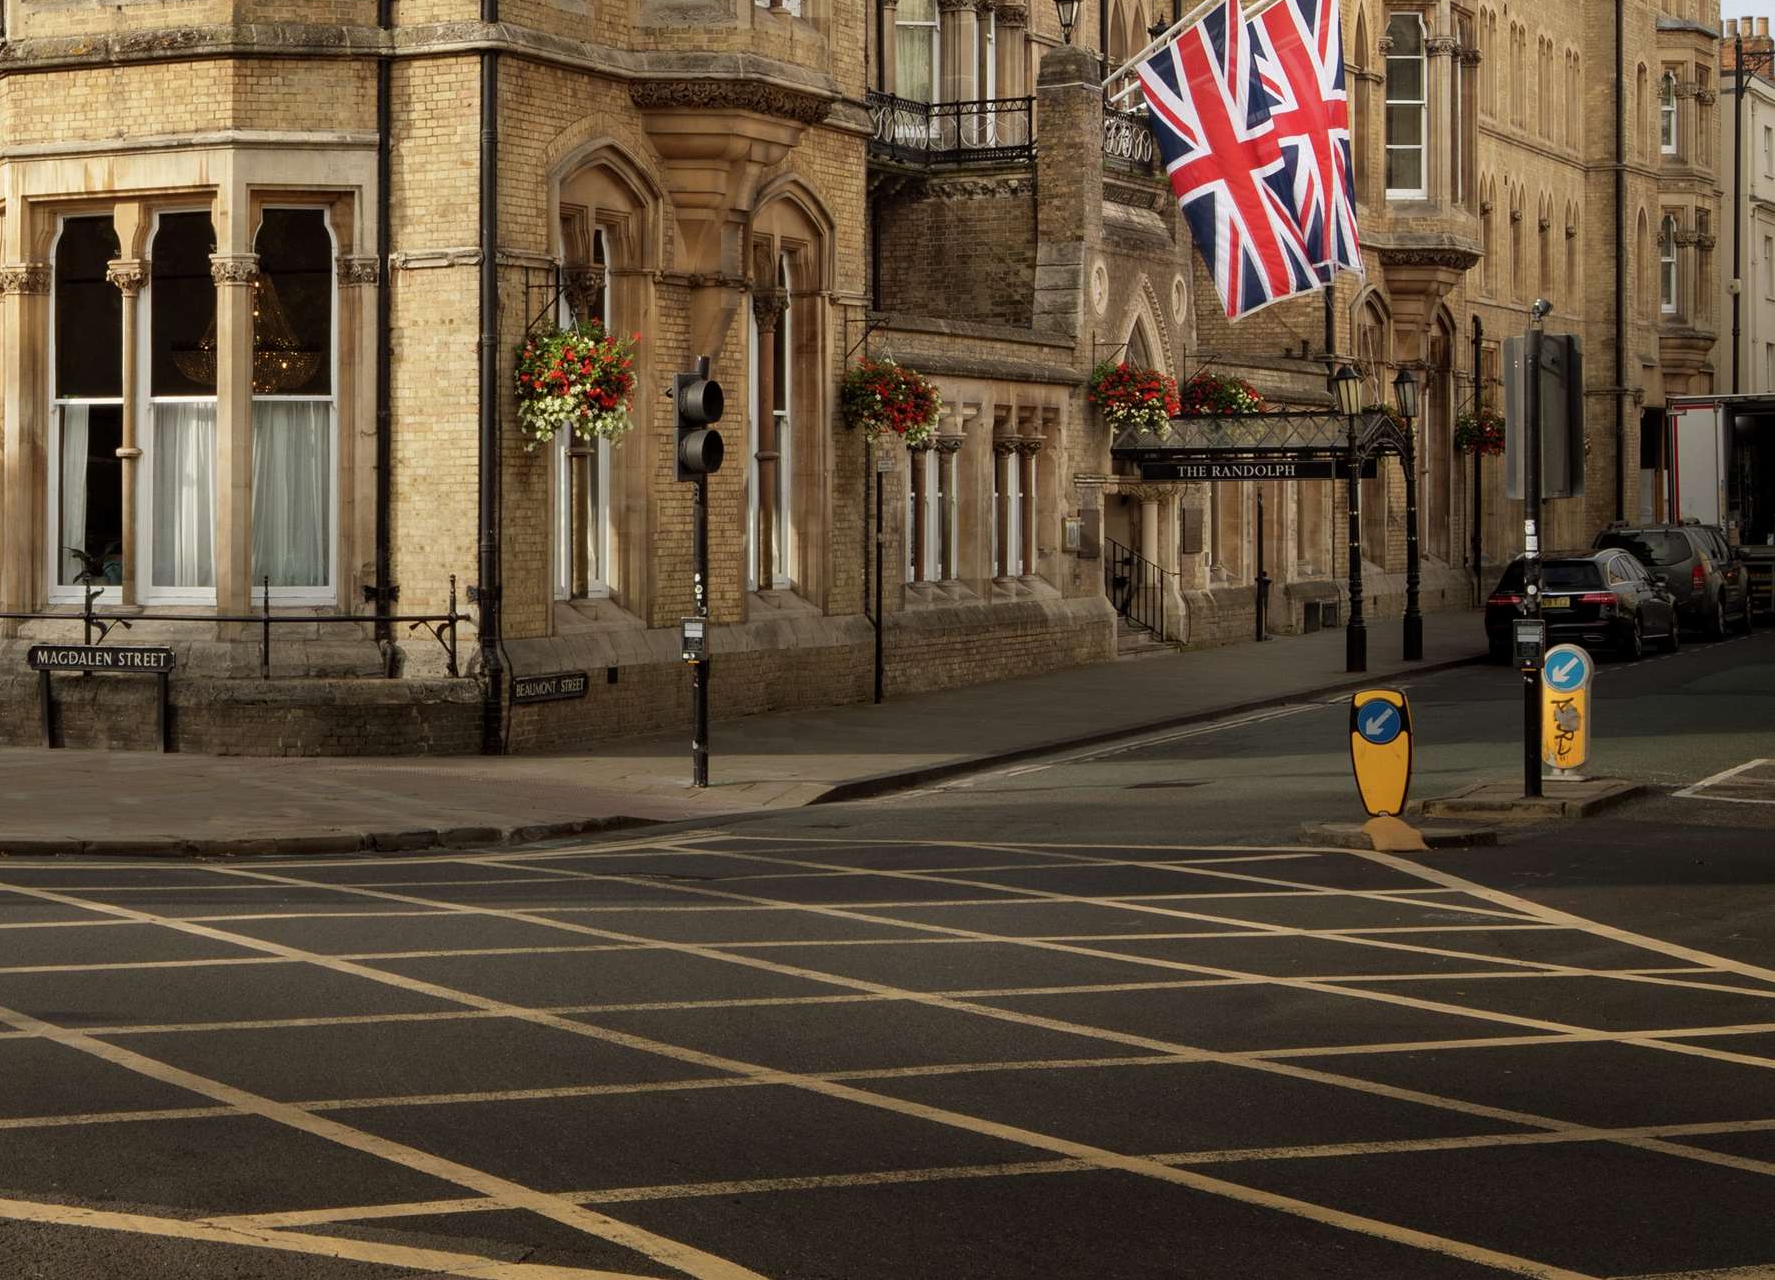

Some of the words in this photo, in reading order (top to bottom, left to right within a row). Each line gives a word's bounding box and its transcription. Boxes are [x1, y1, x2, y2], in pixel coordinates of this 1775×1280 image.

[1176, 465, 1207, 477] THE
[1212, 464, 1296, 477] RANDOLPH
[37, 650, 112, 666] MAGDALEN
[118, 652, 167, 667] STREET
[516, 680, 556, 698] BEAUMONT
[560, 677, 584, 693] STREET
